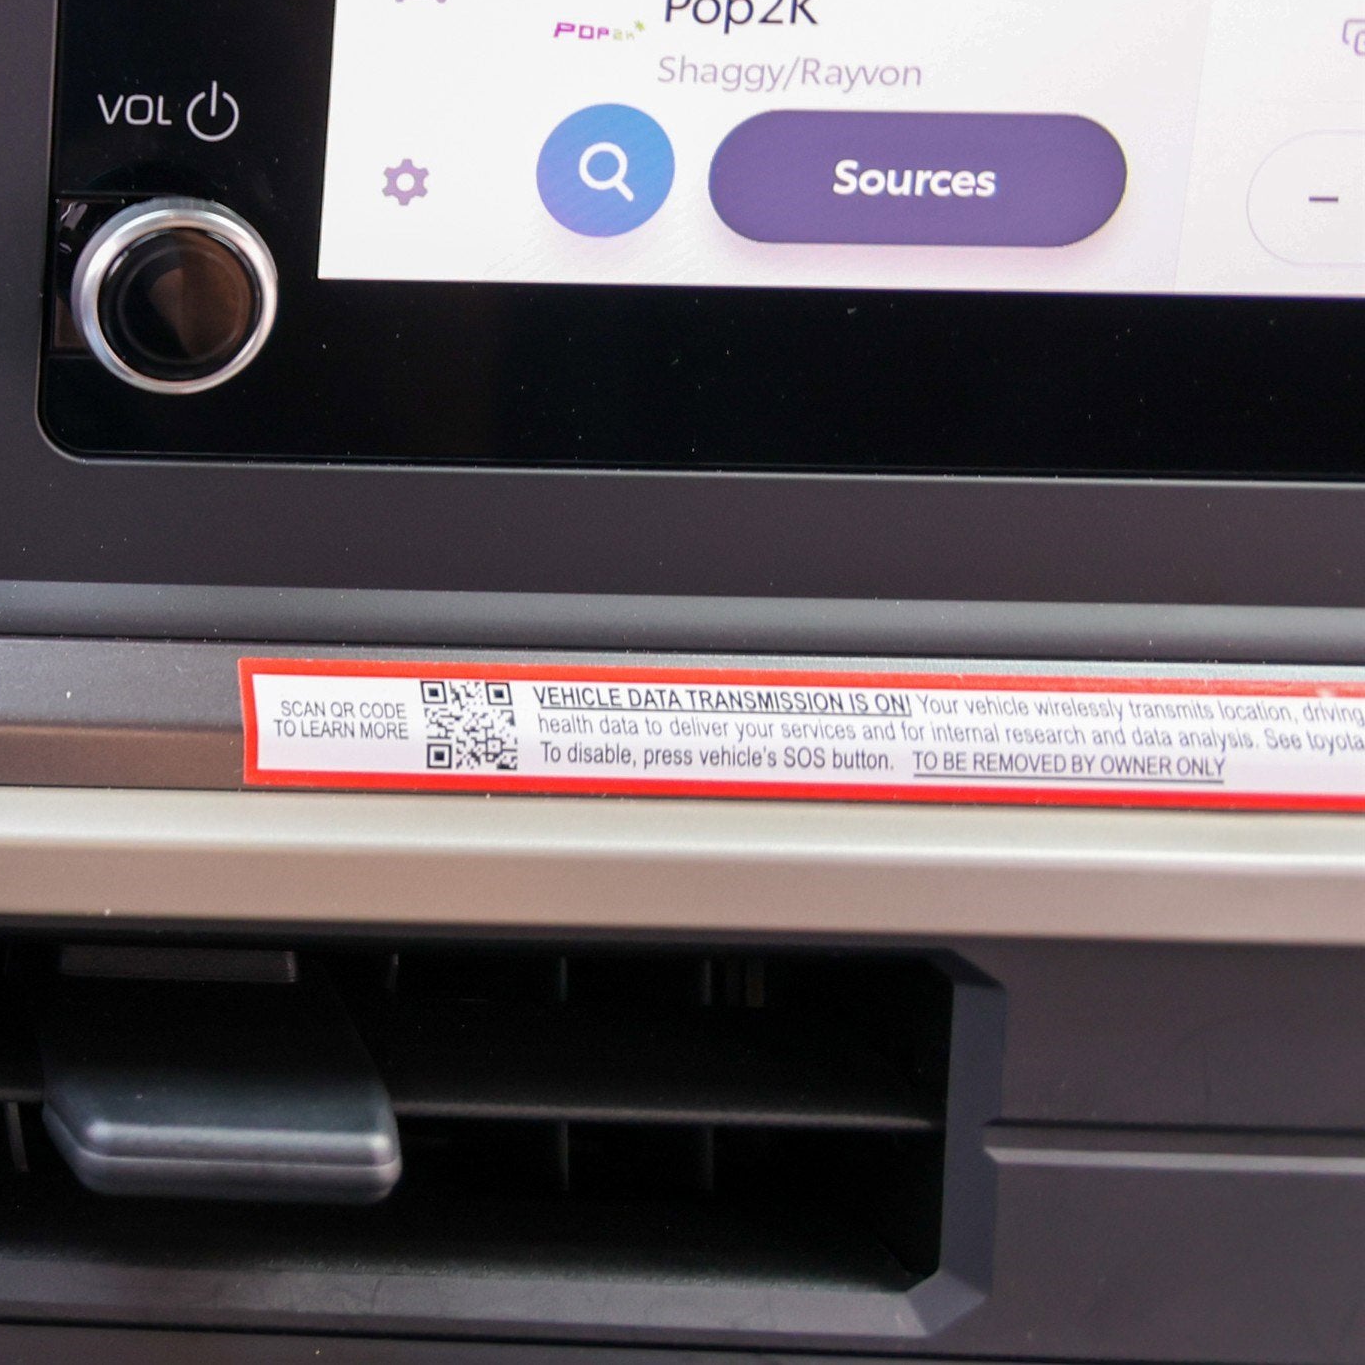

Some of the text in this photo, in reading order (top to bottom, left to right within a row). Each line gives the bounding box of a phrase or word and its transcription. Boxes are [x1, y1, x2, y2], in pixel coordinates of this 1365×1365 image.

[657, 56, 922, 92] Shaggy/Rayvon
[97, 94, 172, 125] VOL
[832, 160, 997, 198] Sources
[281, 701, 407, 719] SCAN QR CODE
[533, 686, 1365, 726] VEHICLE DATA TRANSMISSION IS ON! Your vehicle wirelessly transmits location, driving
[273, 719, 409, 740] TO LEARN MORE
[538, 713, 593, 734] health
[600, 715, 639, 735] data
[645, 717, 662, 735] to
[670, 716, 730, 736] deliver
[735, 721, 774, 743] your
[781, 720, 856, 740] services
[862, 721, 896, 741] and
[900, 722, 925, 741] for
[931, 723, 1000, 743] internal
[1005, 725, 1085, 745] research
[1092, 726, 1126, 746] and
[1132, 727, 1172, 747] data
[1179, 728, 1260, 753] analysis.
[1264, 728, 1302, 750] See
[540, 741, 1227, 777] To disable, press vehicle's SOS button. TO BE REMOVED BY OWNER ONLY
